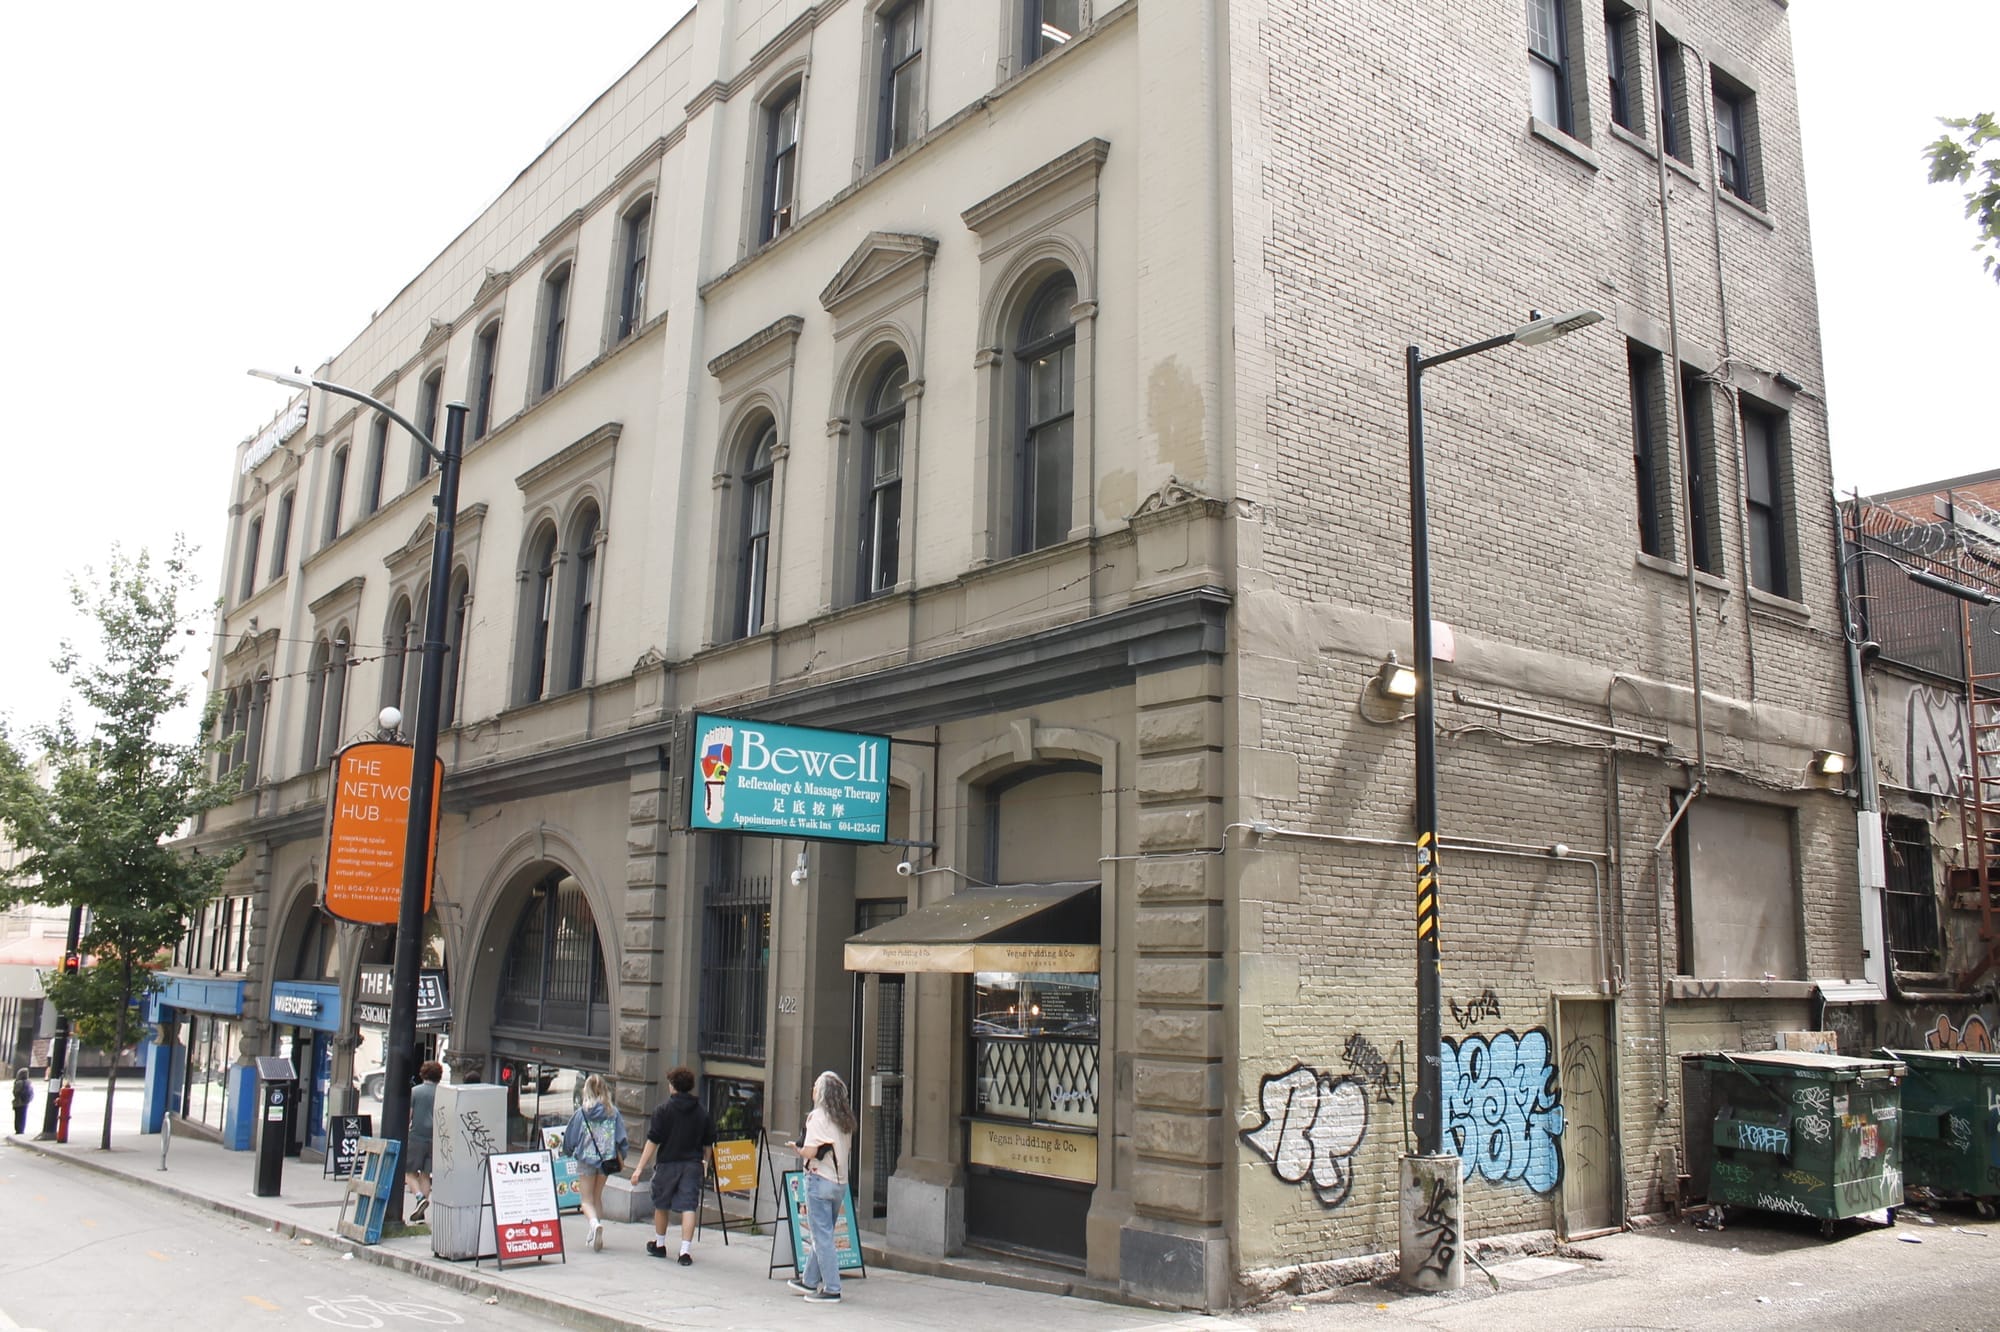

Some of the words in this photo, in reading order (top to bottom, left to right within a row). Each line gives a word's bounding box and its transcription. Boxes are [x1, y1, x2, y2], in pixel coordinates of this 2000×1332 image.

[738, 730, 878, 783] Bewell
[347, 758, 382, 776] THE
[344, 780, 410, 802] NETWO
[738, 776, 792, 794] Reflexology
[794, 781, 803, 794] &
[804, 782, 842, 799] Massage
[844, 786, 881, 803] Therapy
[341, 803, 380, 821] HUB
[772, 798, 845, 819] 足底按摩
[733, 812, 787, 827] Appointments
[789, 818, 796, 827] &
[798, 818, 818, 829] Walk
[819, 820, 832, 830] Ins
[1007, 950, 1027, 959] Vegan
[1028, 949, 1057, 959] Pudding
[361, 972, 384, 994] THE
[417, 998, 437, 1007] UY
[778, 996, 797, 1014] 422
[1051, 1083, 1093, 1104] Open
[988, 1131, 1013, 1146] Vegan
[1015, 1134, 1052, 1152] Pudding
[1054, 1140, 1060, 1149] &
[1062, 1140, 1077, 1153] Co.
[718, 1154, 751, 1163] NETWORK
[718, 1163, 733, 1171] HUB
[1011, 1153, 1053, 1164] organic
[508, 1161, 541, 1175] Visa
